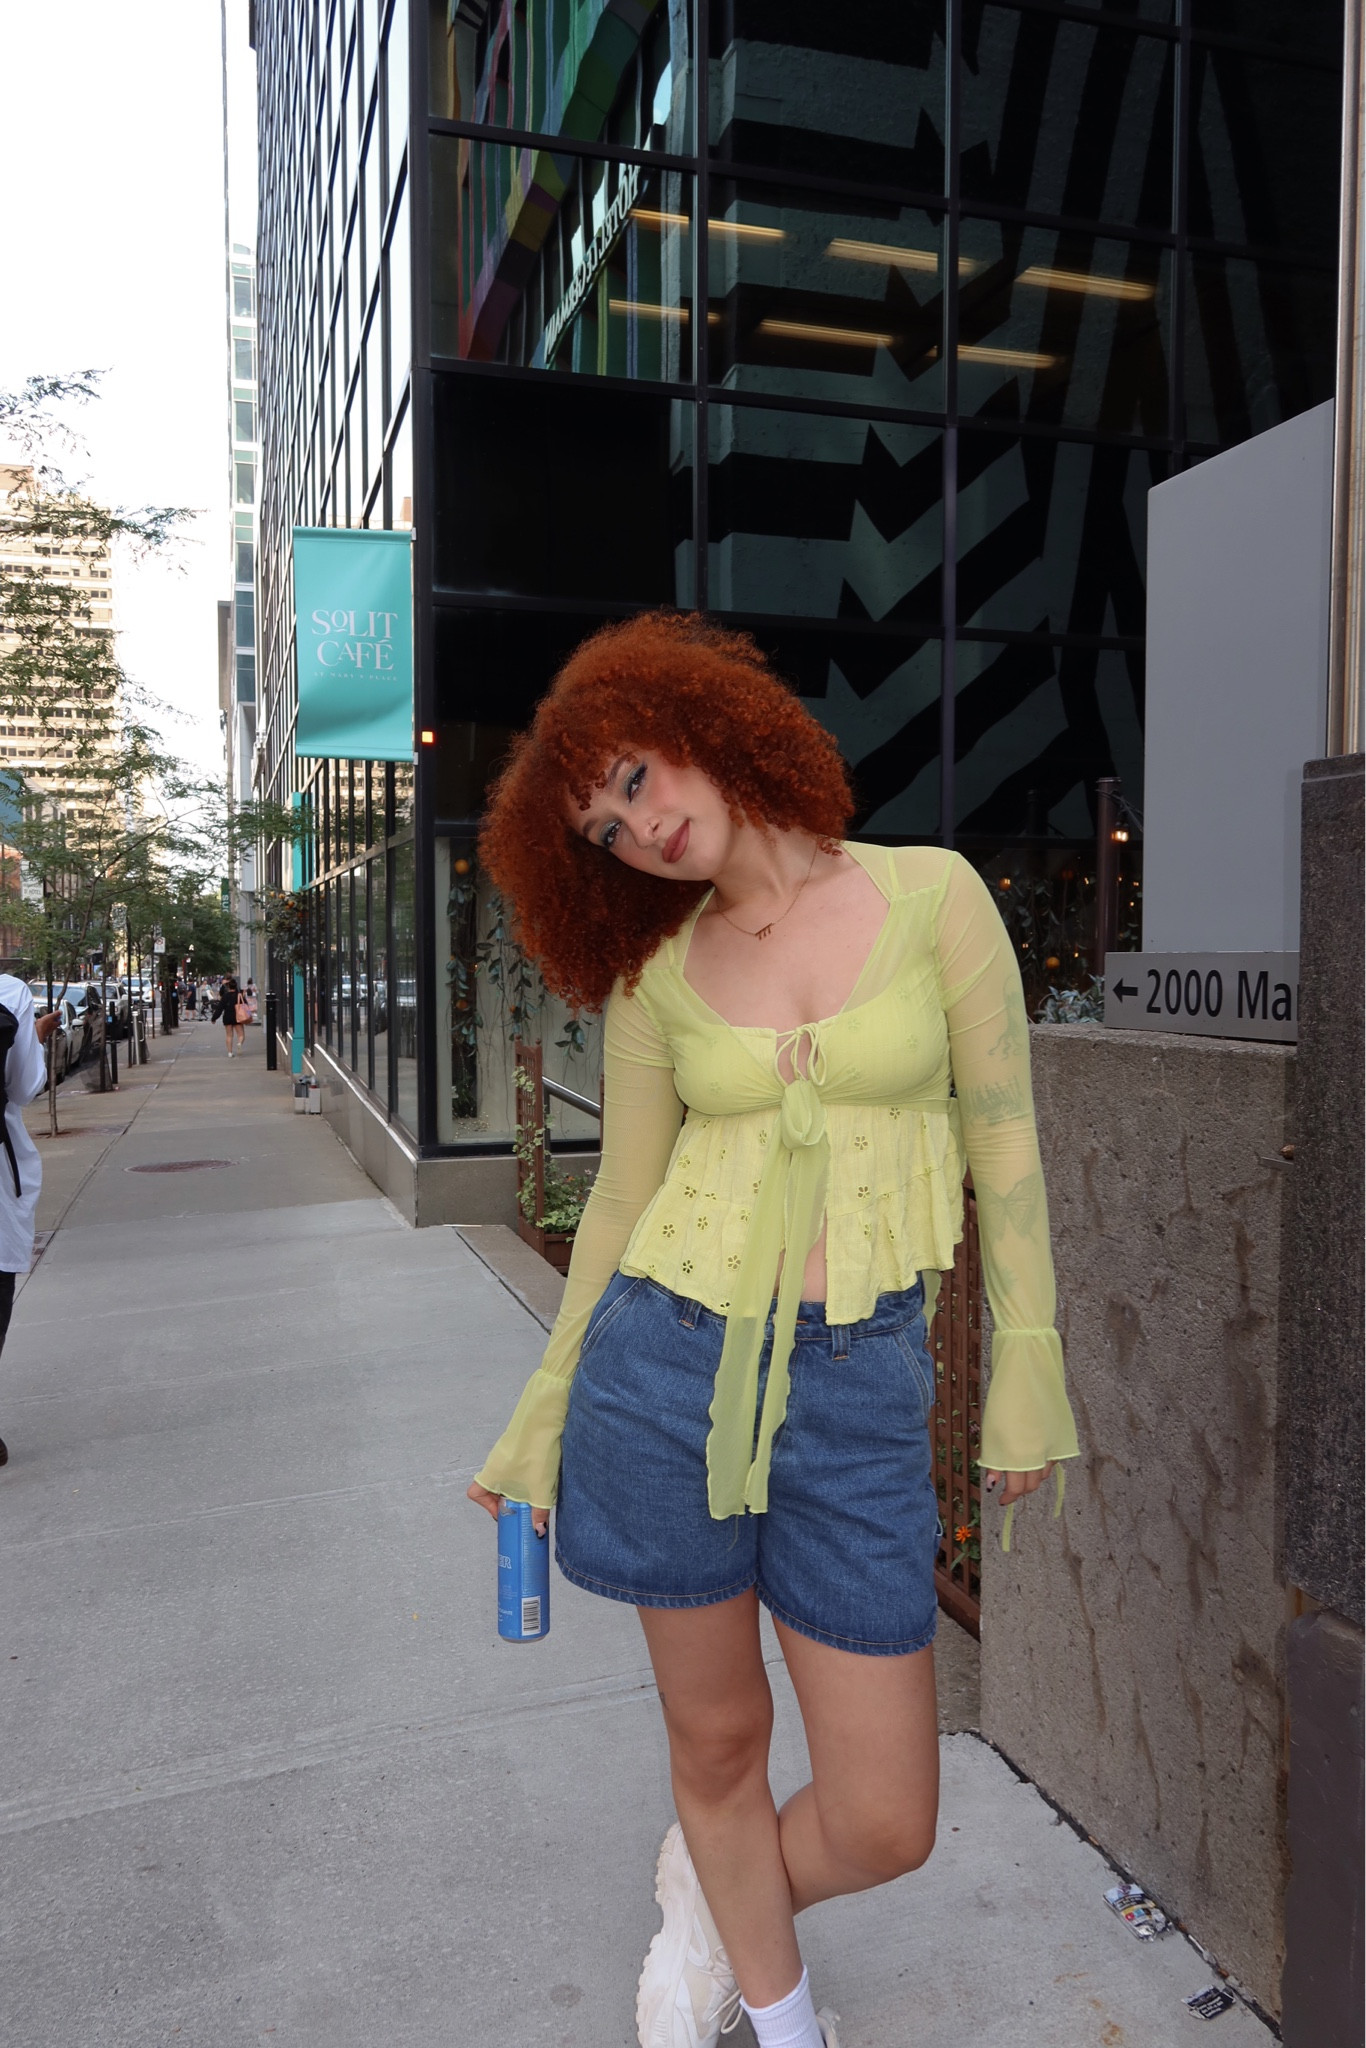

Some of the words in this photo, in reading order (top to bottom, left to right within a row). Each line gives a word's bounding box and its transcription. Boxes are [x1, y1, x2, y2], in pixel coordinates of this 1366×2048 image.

[316, 638, 394, 671] CAFÉ
[1146, 969, 1224, 1018] 2000
[1237, 970, 1300, 1022] Ma
